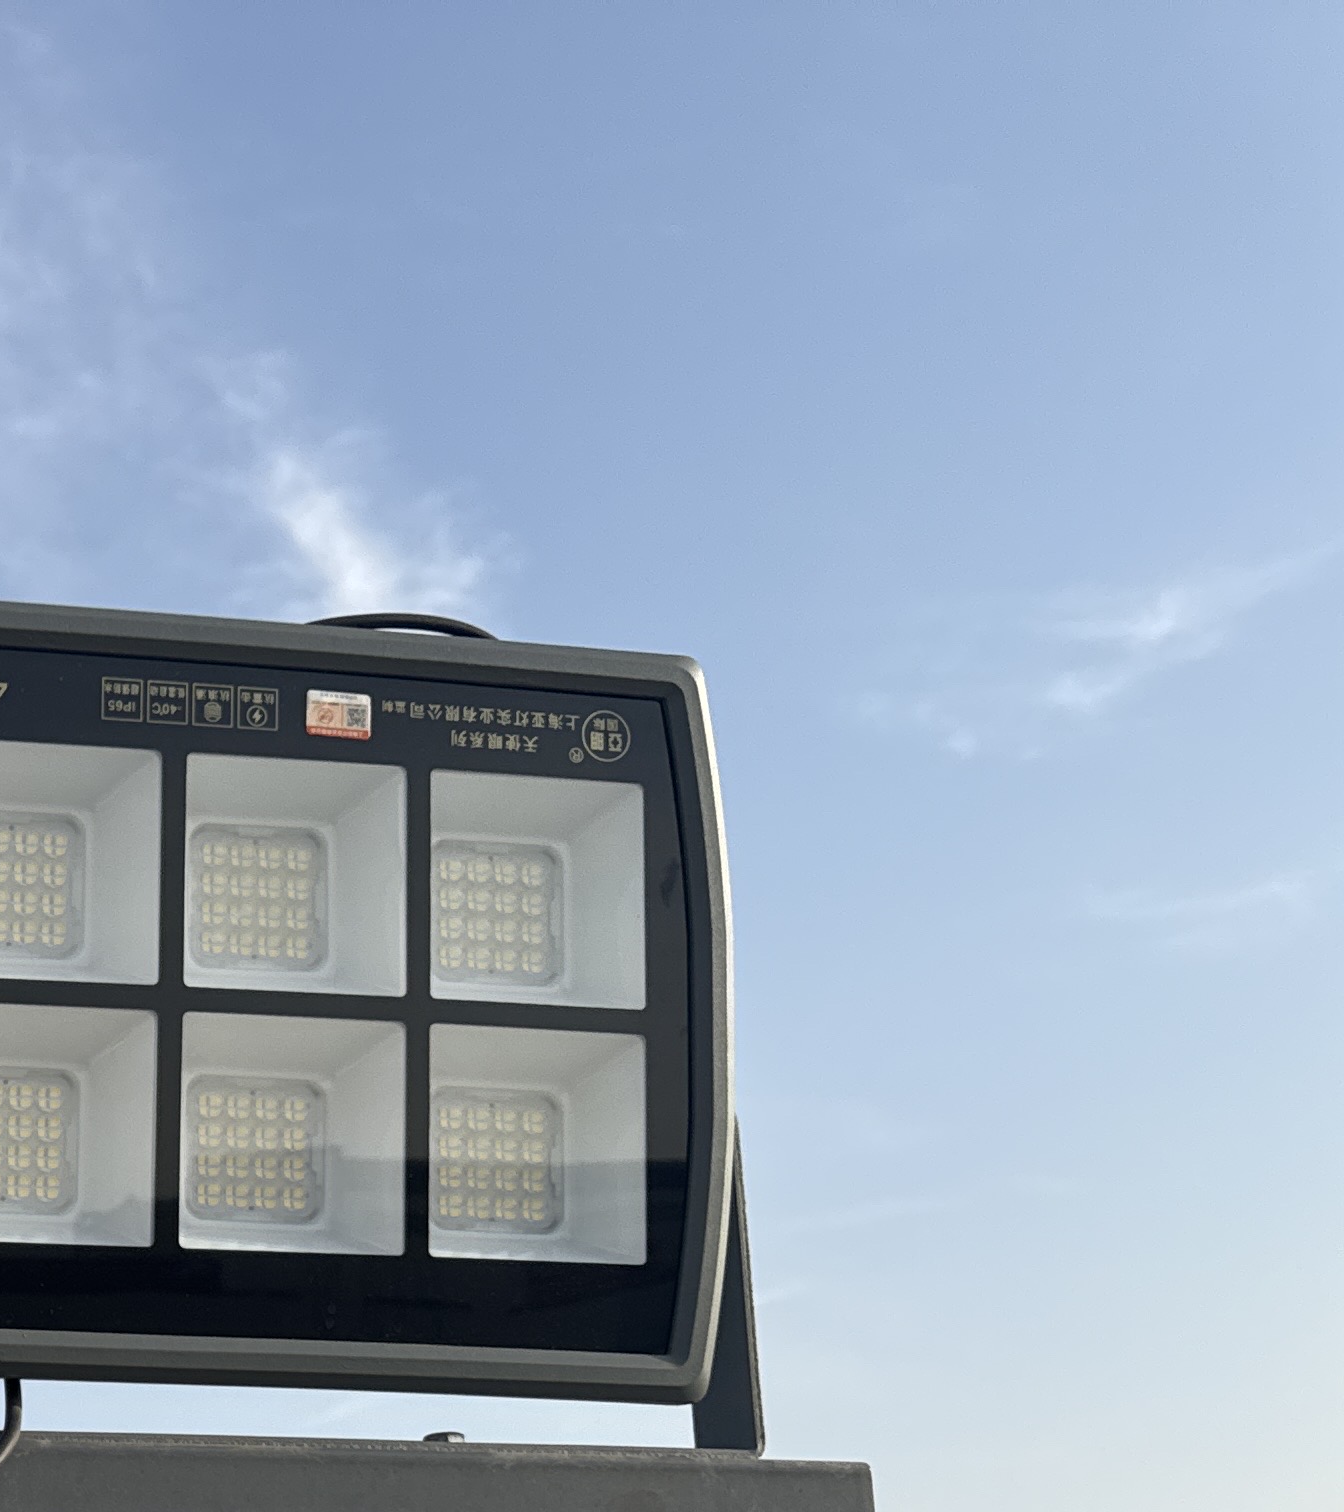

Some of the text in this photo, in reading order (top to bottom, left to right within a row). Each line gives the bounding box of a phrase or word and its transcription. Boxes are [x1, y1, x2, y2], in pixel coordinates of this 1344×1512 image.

[108, 700, 136, 712] IP65
[450, 729, 539, 753] 天使眼系列
